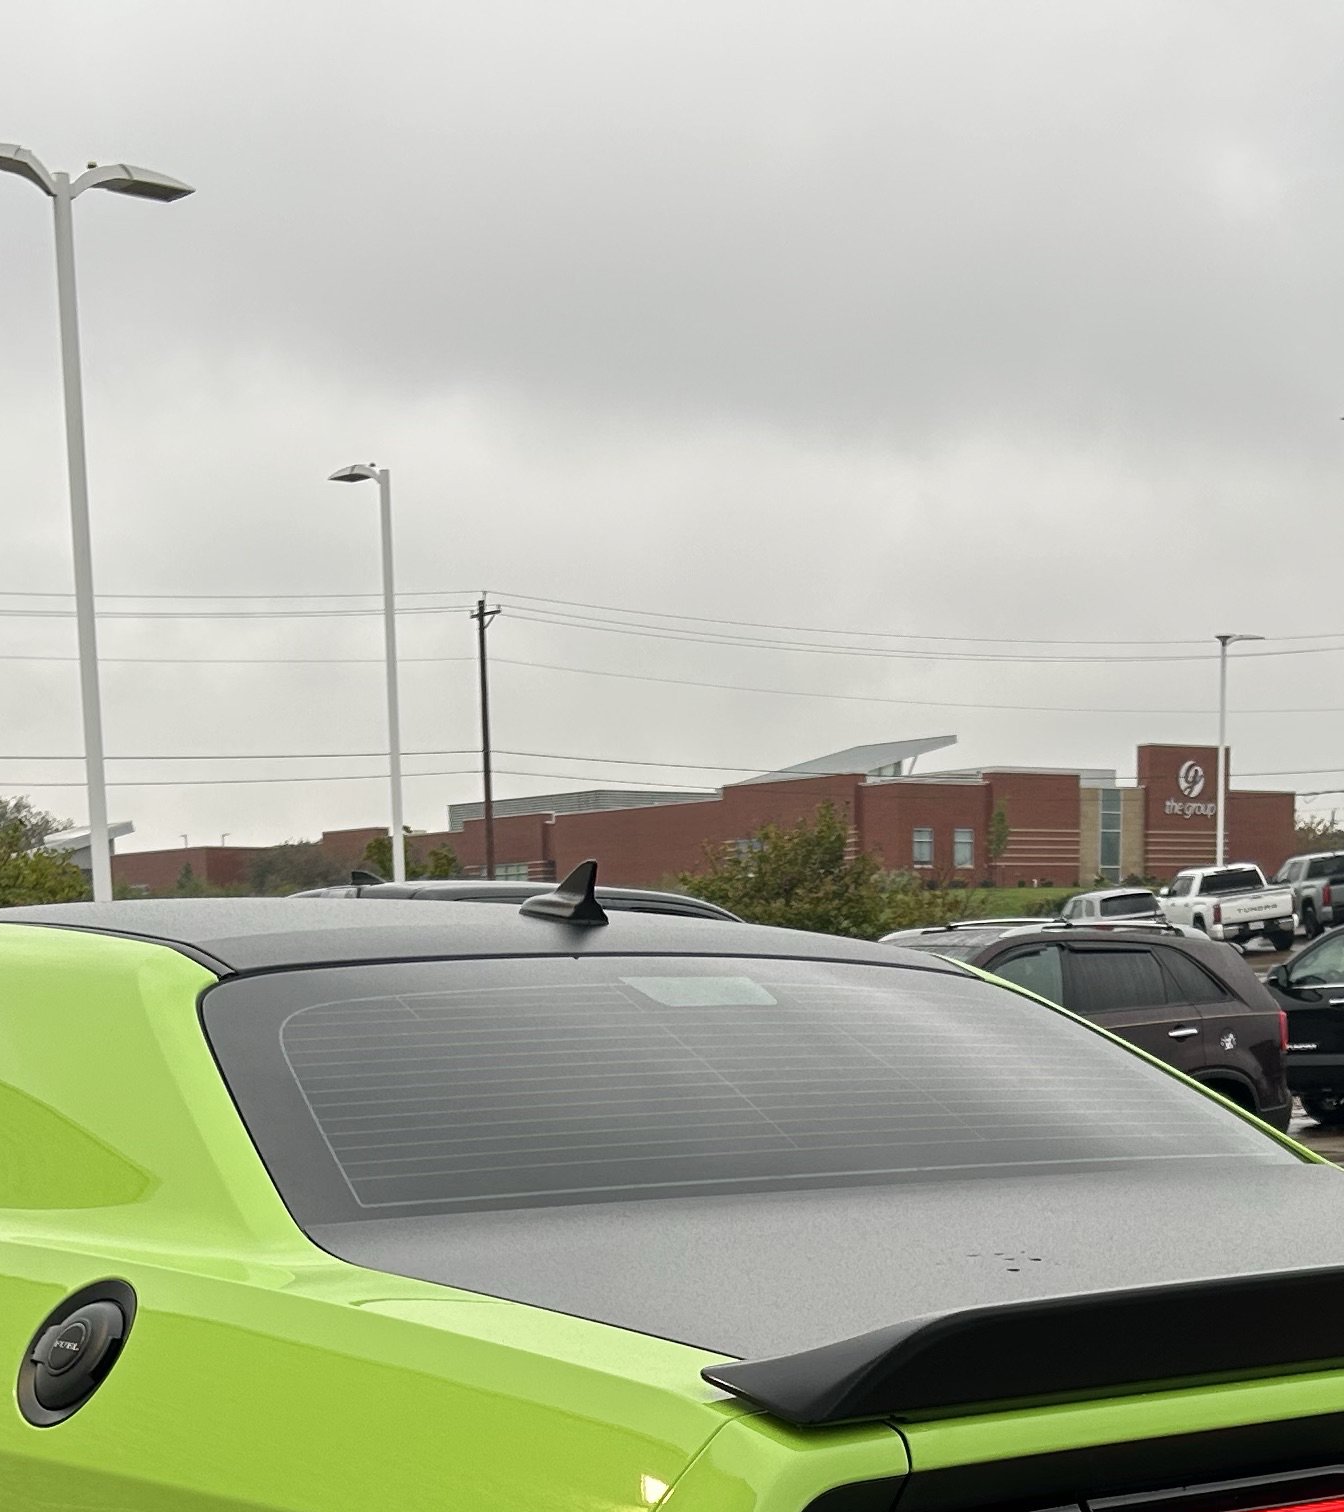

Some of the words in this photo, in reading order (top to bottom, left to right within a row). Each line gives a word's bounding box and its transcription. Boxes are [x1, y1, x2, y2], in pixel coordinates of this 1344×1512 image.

[1164, 799, 1183, 815] the
[1184, 803, 1216, 819] group
[54, 1340, 80, 1351] FUEL
